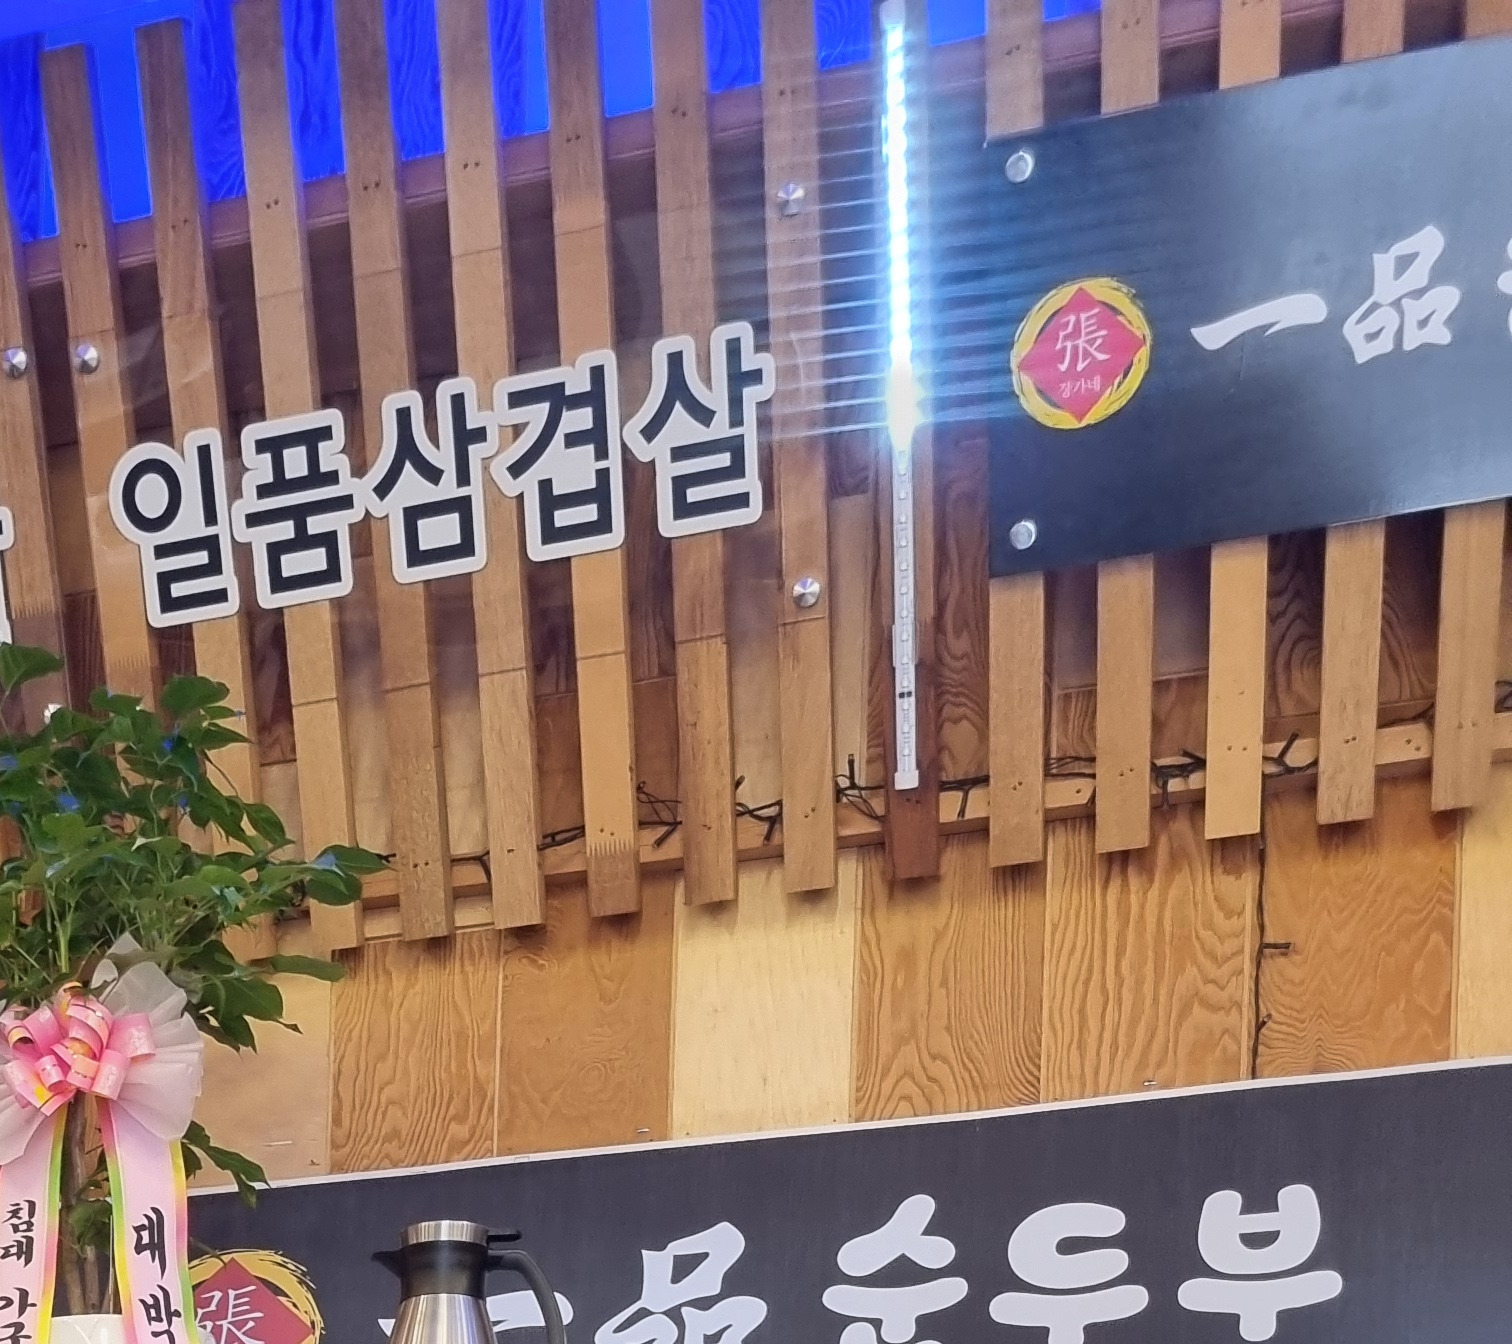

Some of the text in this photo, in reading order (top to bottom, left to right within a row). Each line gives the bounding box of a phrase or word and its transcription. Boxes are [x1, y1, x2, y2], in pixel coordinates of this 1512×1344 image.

[1054, 308, 1112, 373] 張
[1190, 224, 1462, 364] 一品
[118, 333, 767, 617] 일품삼겹살
